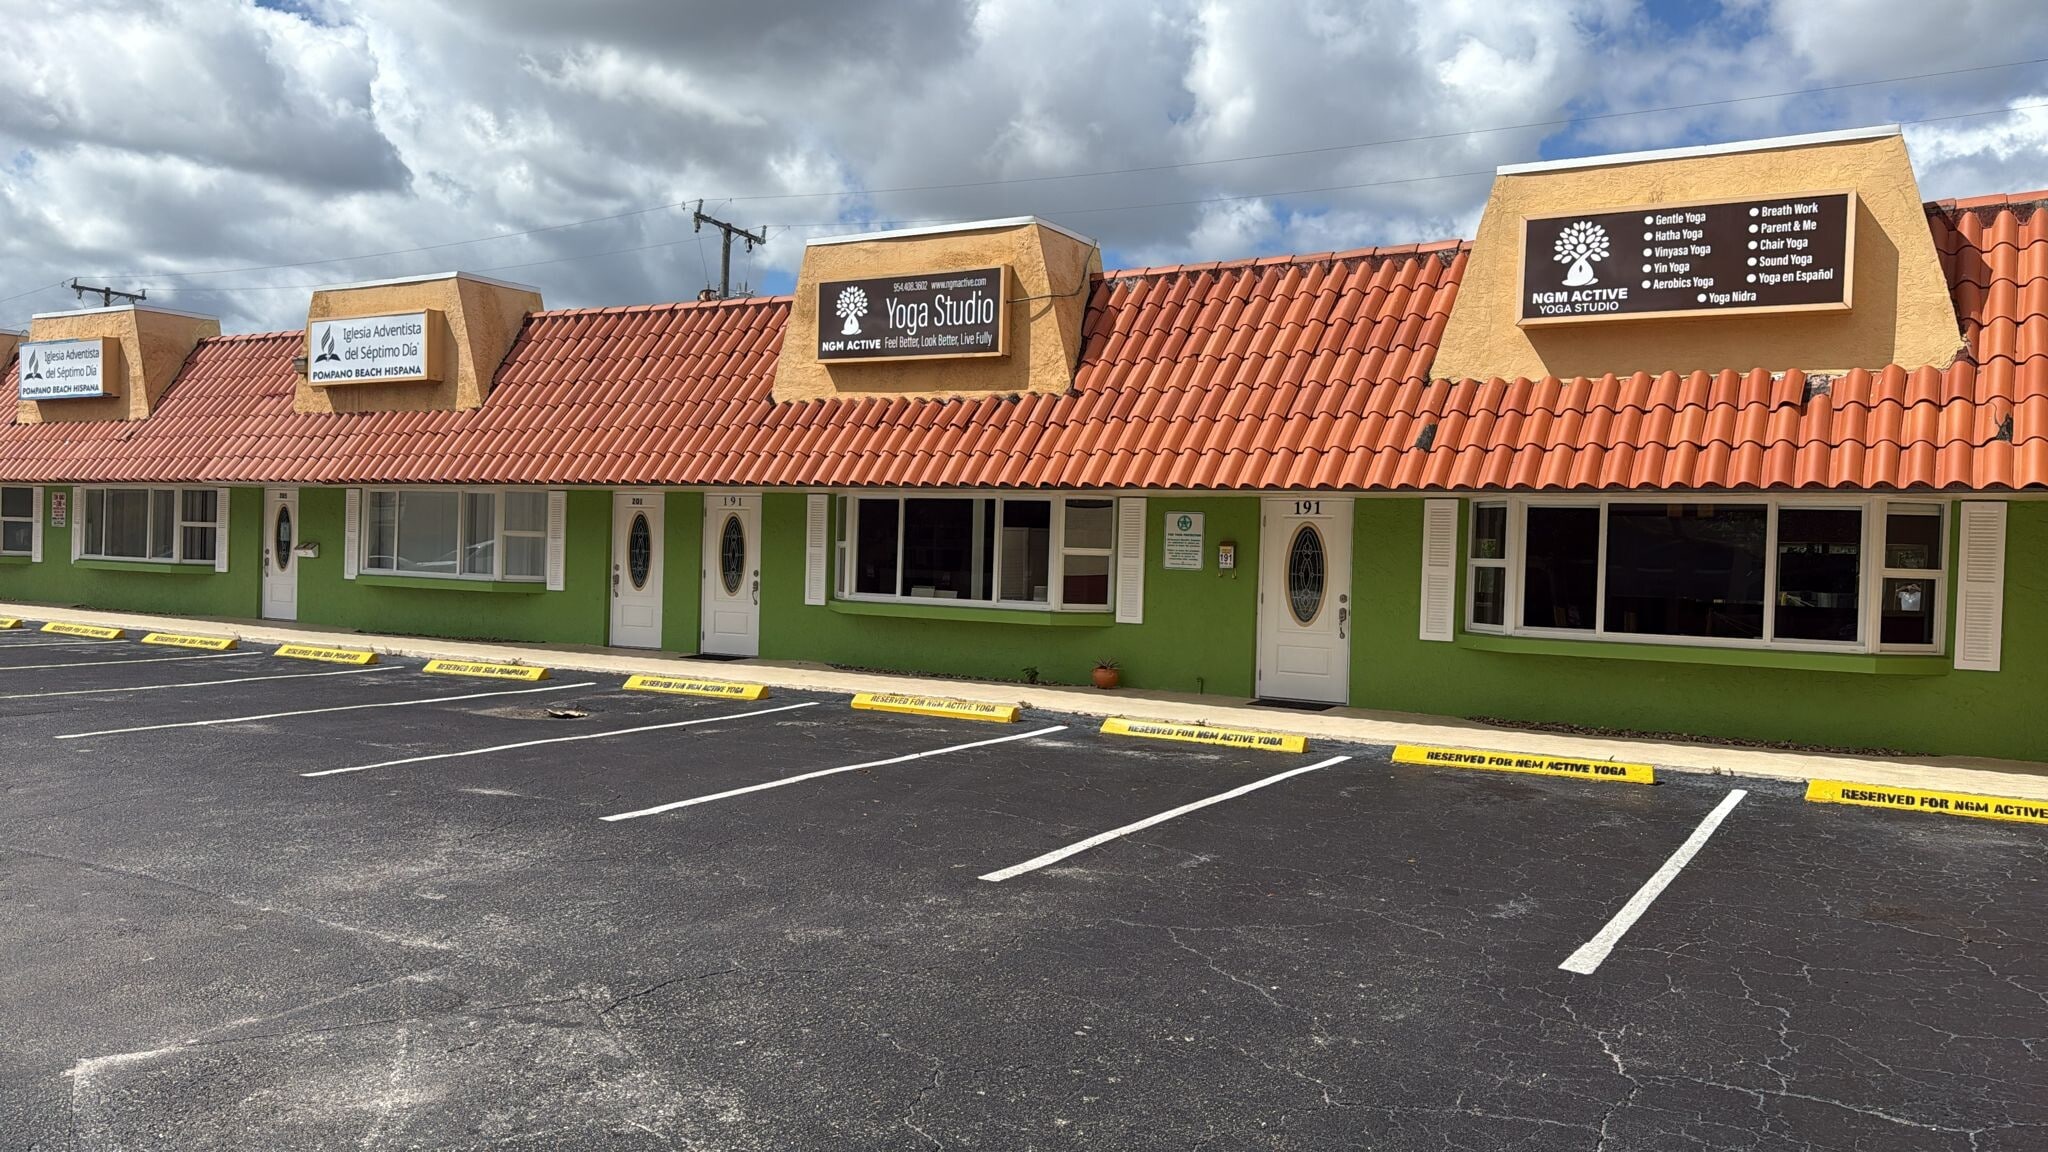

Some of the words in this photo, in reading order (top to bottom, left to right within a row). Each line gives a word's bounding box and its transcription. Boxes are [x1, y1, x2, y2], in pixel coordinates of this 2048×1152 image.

[1761, 204, 1792, 217] Breath
[1794, 202, 1818, 214] Work
[1656, 213, 1683, 225] Gentle
[1685, 212, 1706, 224] Yoga
[1761, 222, 1791, 233] Parent
[1793, 221, 1800, 231] &
[1802, 220, 1817, 230] Me
[1655, 230, 1680, 241] Hatha
[1682, 229, 1703, 241] Yoga
[1655, 246, 1688, 258] Vinyasa
[1690, 244, 1711, 256] Yoga
[1760, 238, 1784, 250] Chair
[1786, 238, 1808, 250] Yoga
[1760, 254, 1788, 267] Sound
[1790, 254, 1812, 266] Yoga
[1654, 263, 1667, 273] Yin
[1669, 262, 1690, 274] Yoga
[1653, 278, 1691, 289] Aerobics
[1693, 277, 1714, 289] Yoga
[1759, 272, 1780, 285] Yoga
[1783, 273, 1794, 282] en
[1796, 268, 1833, 283] Español
[931, 278, 987, 290] www.ngmactive.com
[1532, 291, 1568, 304] NGM
[1571, 288, 1628, 302] ACTIVE
[1709, 292, 1730, 305] Yoga
[1732, 290, 1756, 302] Nidra
[886, 298, 928, 336] Yoga
[934, 290, 994, 327] Studio
[1540, 304, 1572, 314] YOGA
[1574, 302, 1619, 312] STUDIO
[343, 328, 371, 343] Iglesia
[373, 323, 421, 338] Adventista
[885, 336, 898, 349] Feel
[900, 335, 919, 349] Better,
[921, 334, 937, 347] Look
[938, 333, 959, 347] Better,
[961, 332, 974, 345] Live
[976, 331, 992, 347] Fully
[345, 348, 358, 360] del
[361, 345, 400, 362] Séptimo
[402, 343, 417, 356] Día
[822, 341, 844, 352] NGM
[847, 339, 881, 350] ACTIVE
[44, 351, 64, 365] Iglesia
[66, 348, 99, 360] Adventista
[46, 369, 55, 379] del
[57, 367, 84, 380] Séptimo
[86, 366, 96, 376] Día
[313, 370, 353, 380] POMPANO
[355, 368, 382, 377] BEACH
[384, 365, 421, 376] HISPANA
[23, 386, 51, 395] POMPANO
[53, 385, 72, 393] BEACH
[73, 384, 99, 392] HISPANA
[724, 496, 742, 506] 191
[1294, 501, 1321, 515] 191
[1220, 553, 1232, 562] 191
[437, 663, 469, 671] RESERVED
[496, 668, 529, 676] POMPANO
[640, 680, 672, 688] RESERVED
[702, 684, 726, 692] ACTIVE
[726, 686, 744, 694] YOGA
[870, 695, 909, 705] RESERVED
[909, 698, 925, 706] FOR
[926, 700, 943, 708] NGM
[945, 701, 972, 711] ACTIVE
[975, 704, 996, 712] YOGA
[1128, 725, 1174, 735] RESERVED
[1176, 729, 1194, 738] FOR
[1196, 730, 1219, 740] NGM
[1220, 733, 1255, 744] ACTIVE
[1257, 736, 1283, 746] YOGA
[1426, 751, 1486, 764] RESERVED
[1488, 756, 1512, 767] FOR
[1515, 759, 1543, 769] NGM
[1546, 761, 1589, 773] ACTIVE
[1593, 764, 1626, 776] YOGA
[1841, 788, 1916, 805] RESERVED
[1920, 797, 1949, 809] FOR
[1954, 800, 1989, 813] NGM
[1994, 804, 2048, 819] ACTIVE
